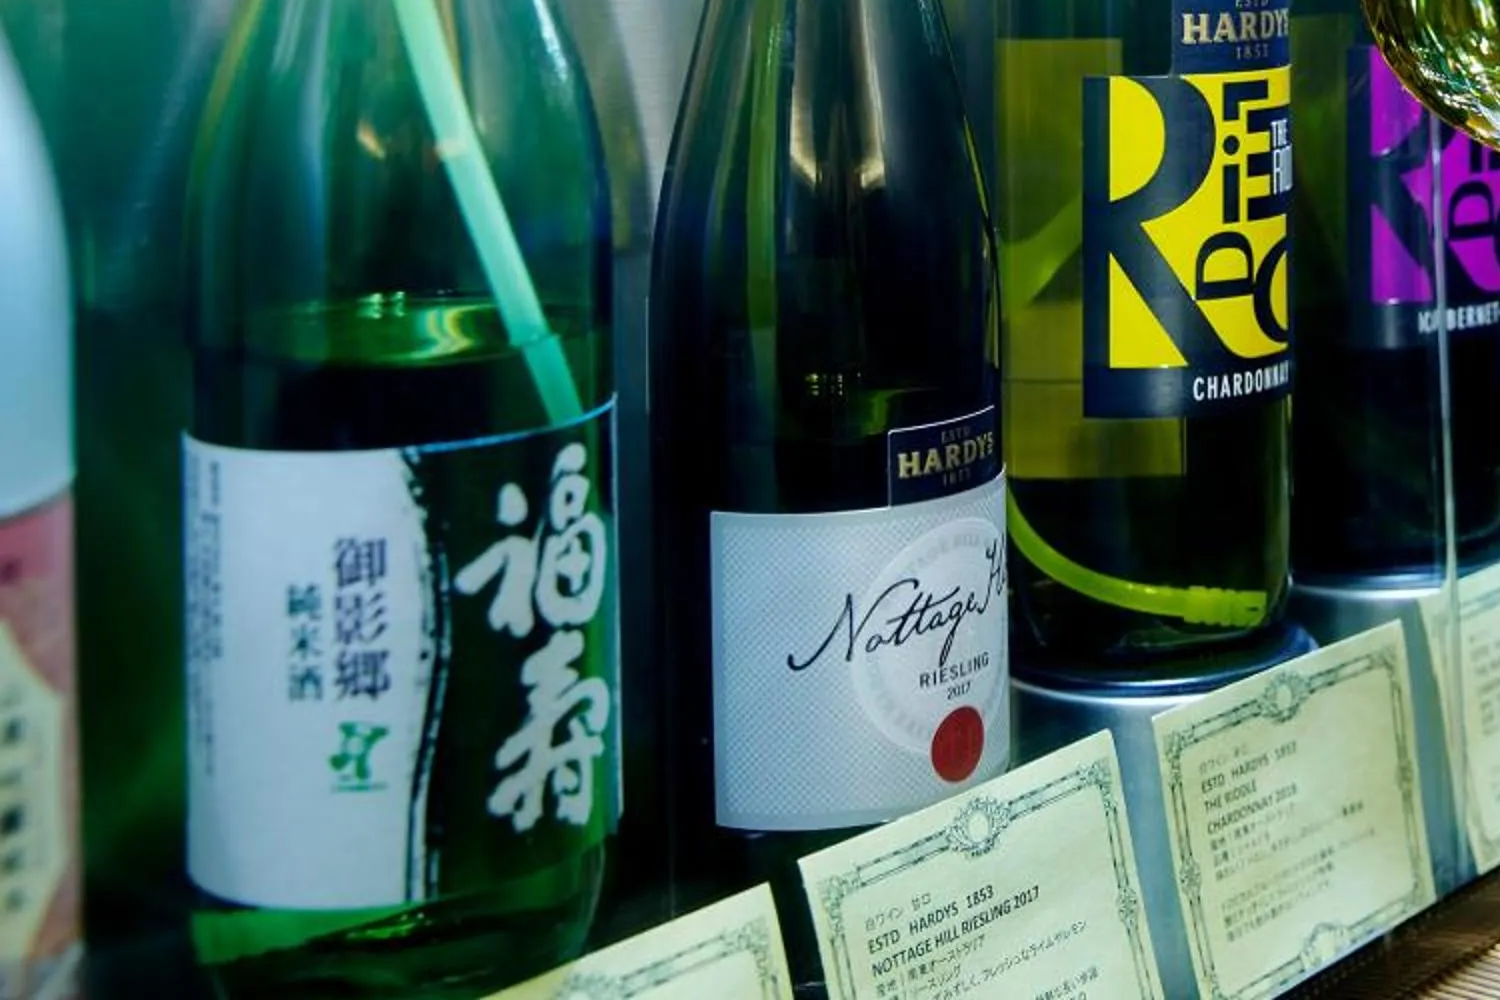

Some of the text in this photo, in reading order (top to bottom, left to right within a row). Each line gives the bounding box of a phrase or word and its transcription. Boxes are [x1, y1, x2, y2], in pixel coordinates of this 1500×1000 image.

[333, 537, 392, 701] 御影郷
[787, 577, 979, 671] Nottage
[919, 651, 990, 688] RIESLING
[947, 681, 972, 699] 2017
[1201, 773, 1225, 794] ESTD
[1204, 794, 1222, 814] THE
[1207, 793, 1273, 835] CHARDONNAY
[867, 884, 994, 955] ESTD HARDYS 1853
[871, 885, 1039, 978] NOTTAGE HILL RIESLING 2017
